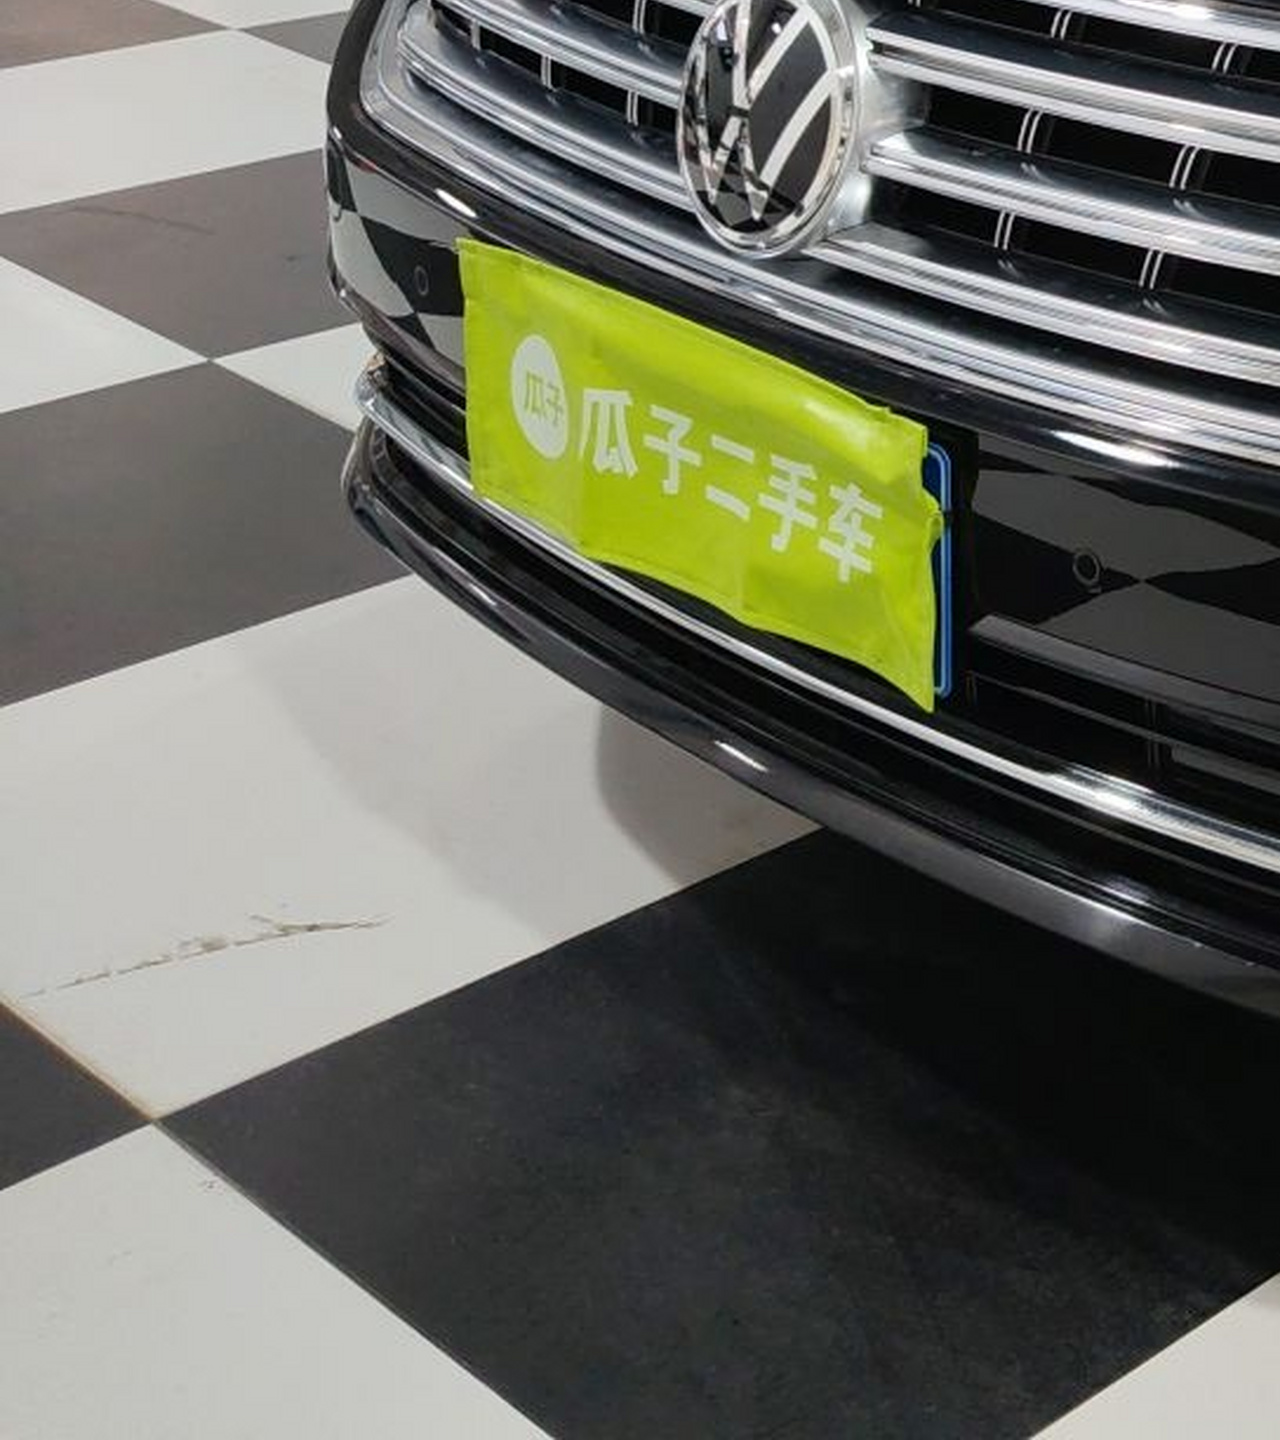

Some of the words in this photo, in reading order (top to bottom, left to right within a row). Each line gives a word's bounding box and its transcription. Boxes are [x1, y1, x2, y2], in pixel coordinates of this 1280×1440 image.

[523, 368, 564, 427] 瓜子
[579, 387, 884, 585] 瓜子二手车
